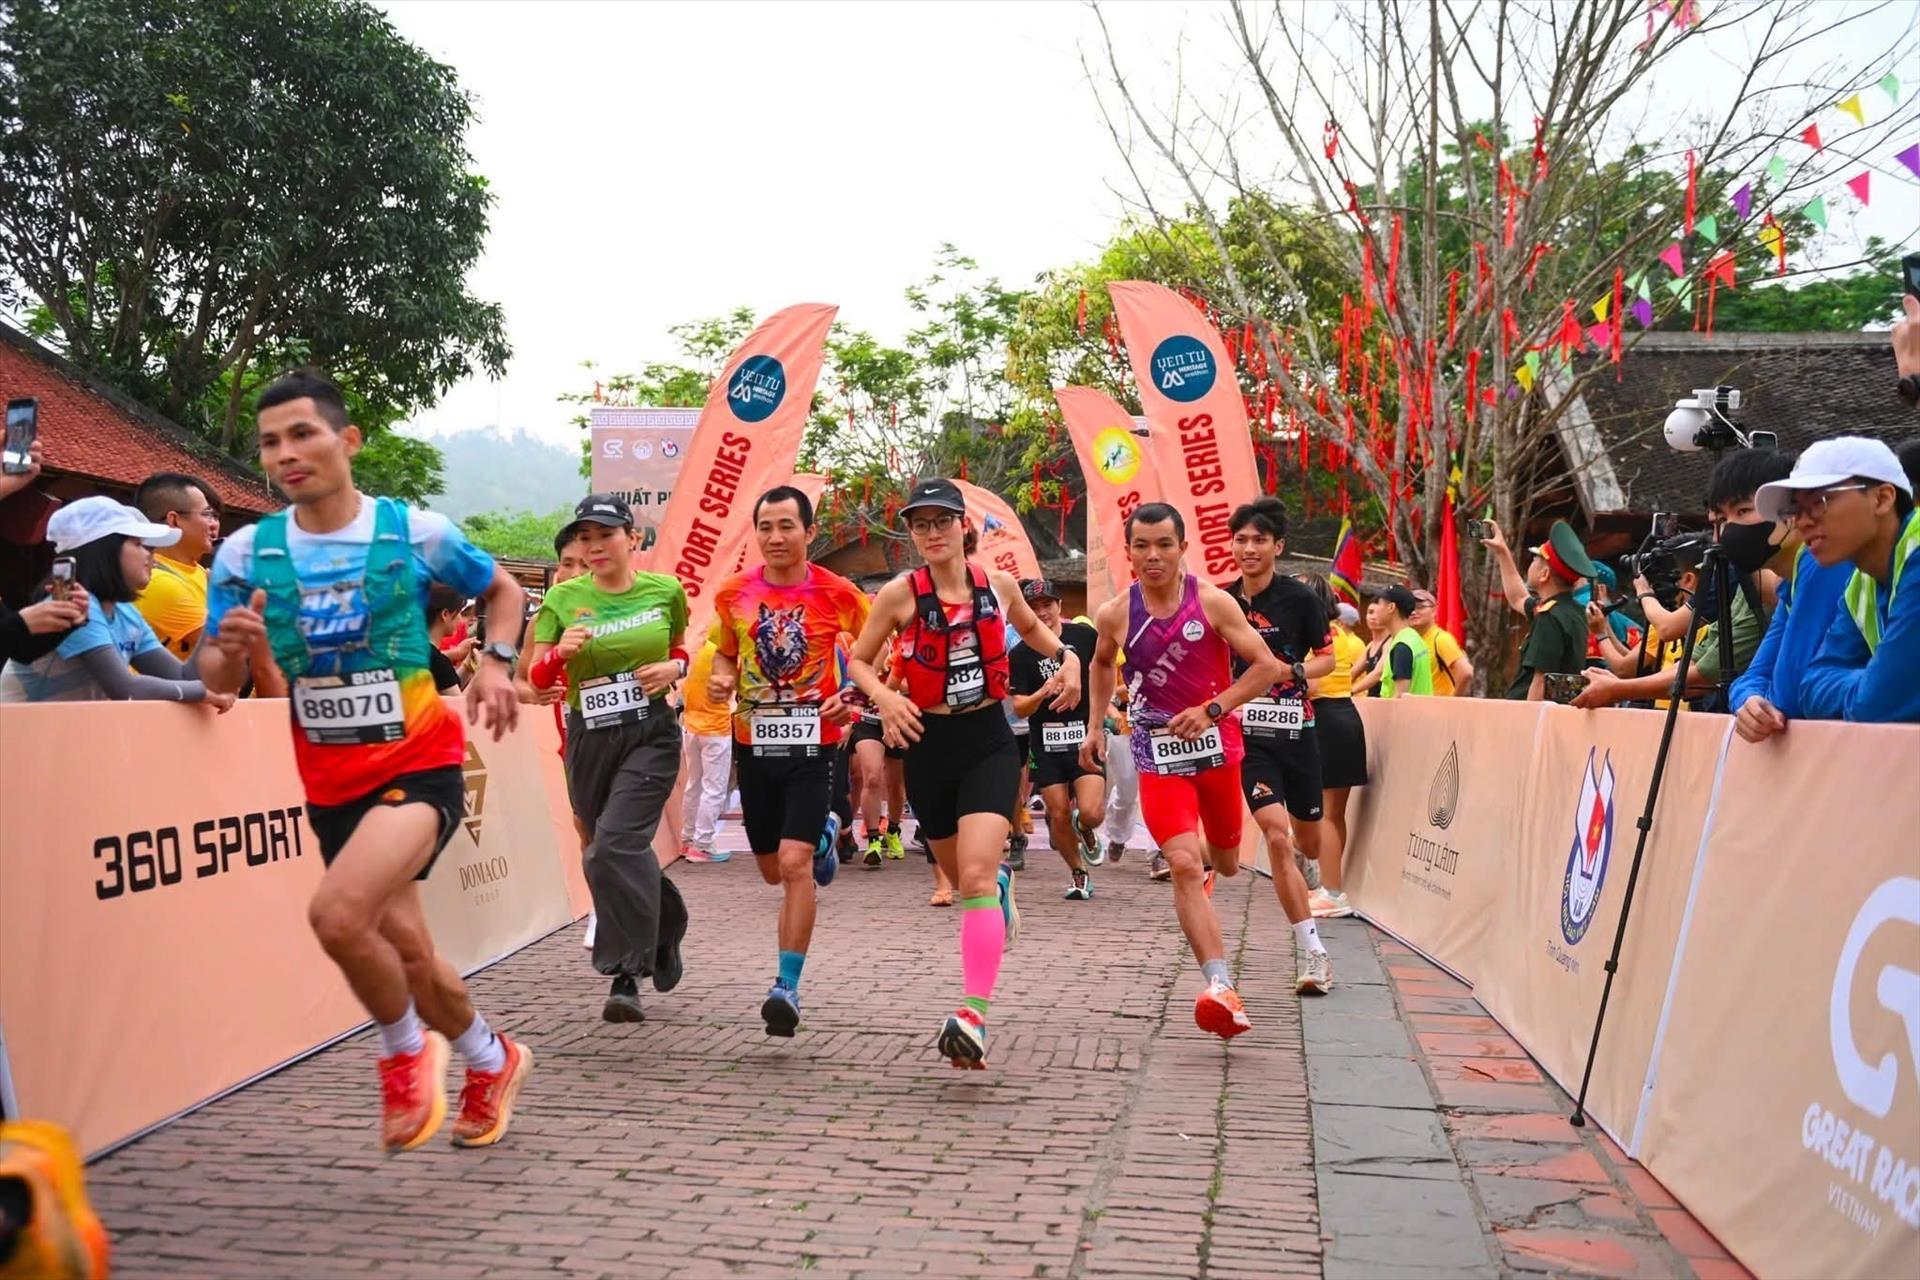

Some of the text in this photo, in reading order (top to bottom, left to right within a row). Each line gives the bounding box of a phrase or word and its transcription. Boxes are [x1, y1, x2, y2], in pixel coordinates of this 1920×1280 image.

[658, 491, 672, 505] P
[1178, 413, 1240, 575] SPORT SERIES
[676, 432, 752, 598] SPORT SERIES
[351, 668, 394, 685] 8KM
[303, 692, 394, 720] 88070
[585, 686, 644, 711] 88318
[1280, 698, 1302, 706] 8KM
[791, 707, 819, 717] 8KM
[1247, 709, 1299, 724] 88286
[755, 723, 816, 739] 88357
[1046, 730, 1084, 742] 88188
[1157, 734, 1218, 758] 88006
[94, 806, 303, 900] 360 SPORT
[459, 856, 509, 891] DOMACO
[1802, 1103, 1920, 1230] GREAT RAC
[1829, 1183, 1882, 1238] VIETNAM
